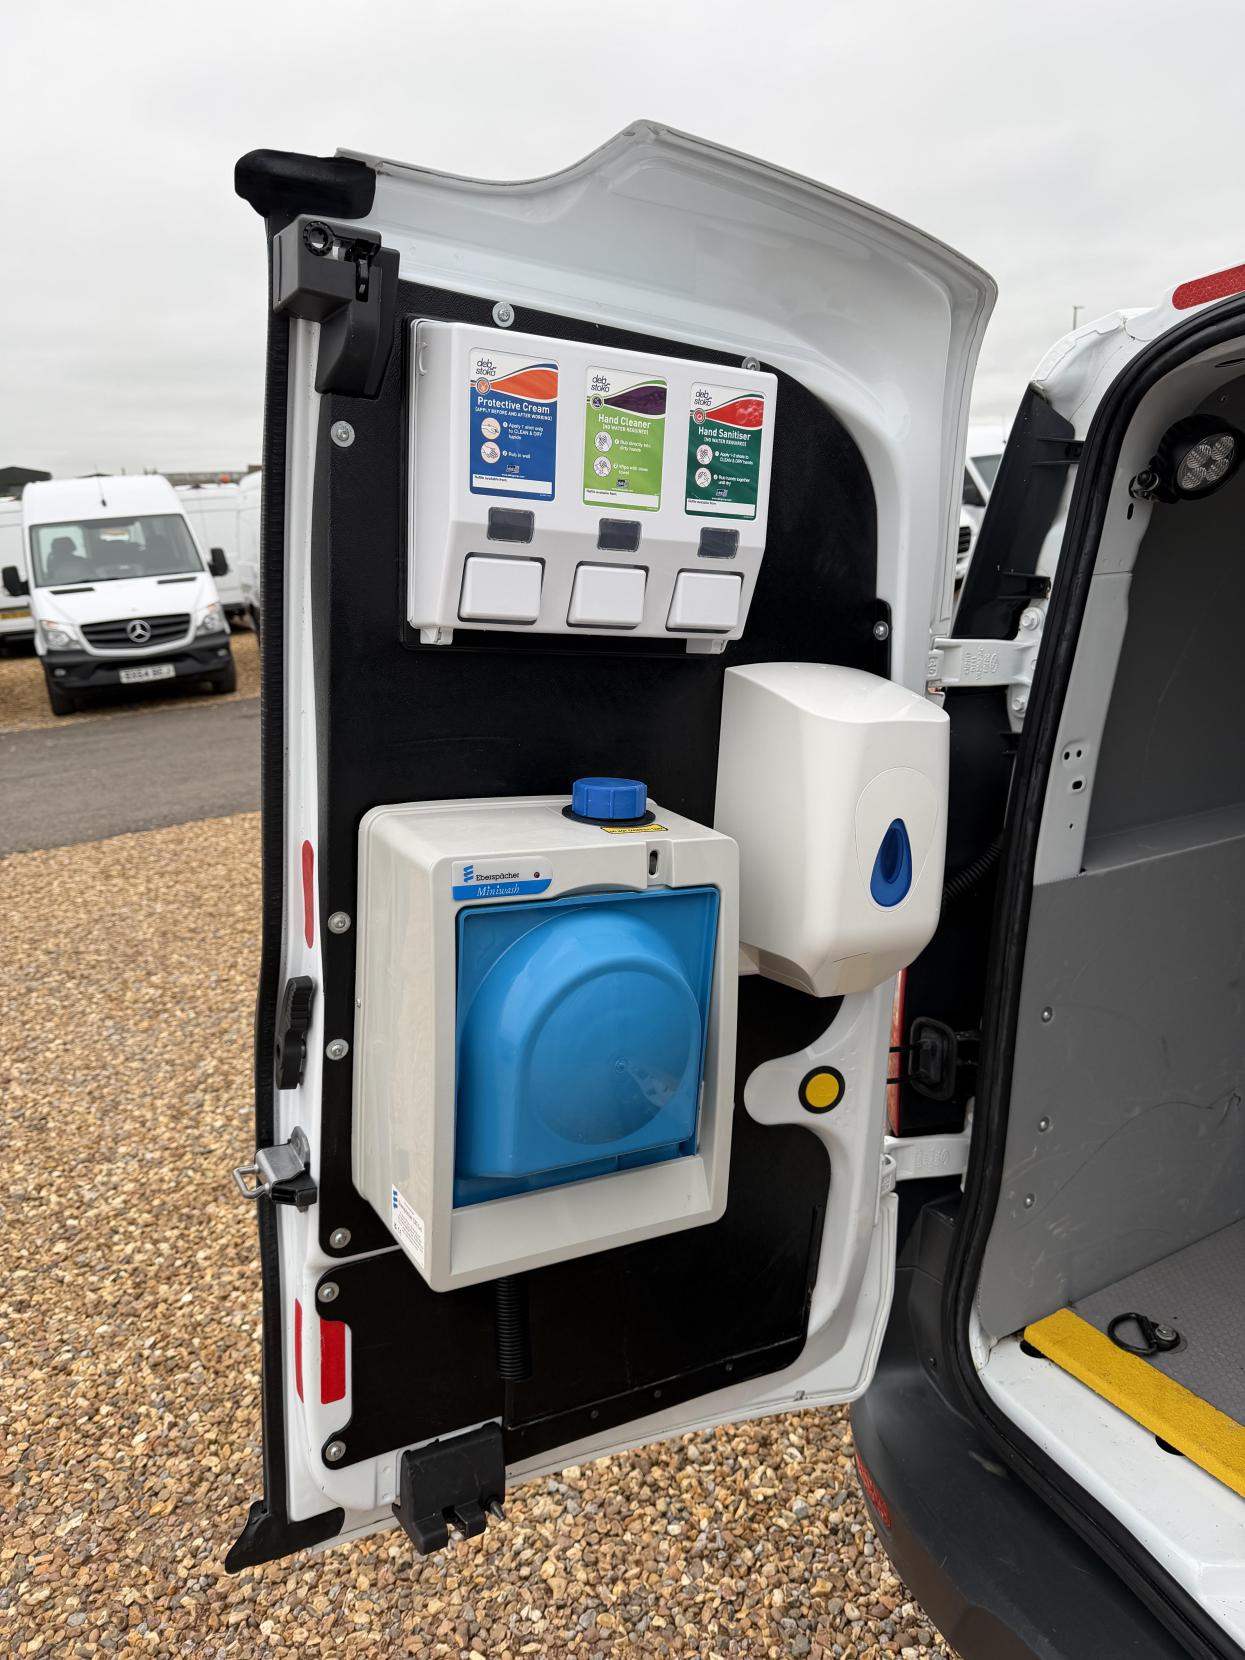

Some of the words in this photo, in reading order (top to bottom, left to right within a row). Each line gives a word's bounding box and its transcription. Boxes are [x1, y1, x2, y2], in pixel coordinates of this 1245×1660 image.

[477, 358, 492, 368] deb
[593, 375, 606, 384] deb
[696, 389, 709, 398] deb
[477, 397, 520, 410] Protective
[523, 403, 550, 414] Cream
[599, 414, 618, 424] Hand
[621, 417, 651, 428] Cleaner
[699, 427, 717, 436] Hand
[719, 429, 751, 440] Sanitiser
[476, 872, 520, 881] Eberspächer
[477, 884, 520, 897] Miniwash
